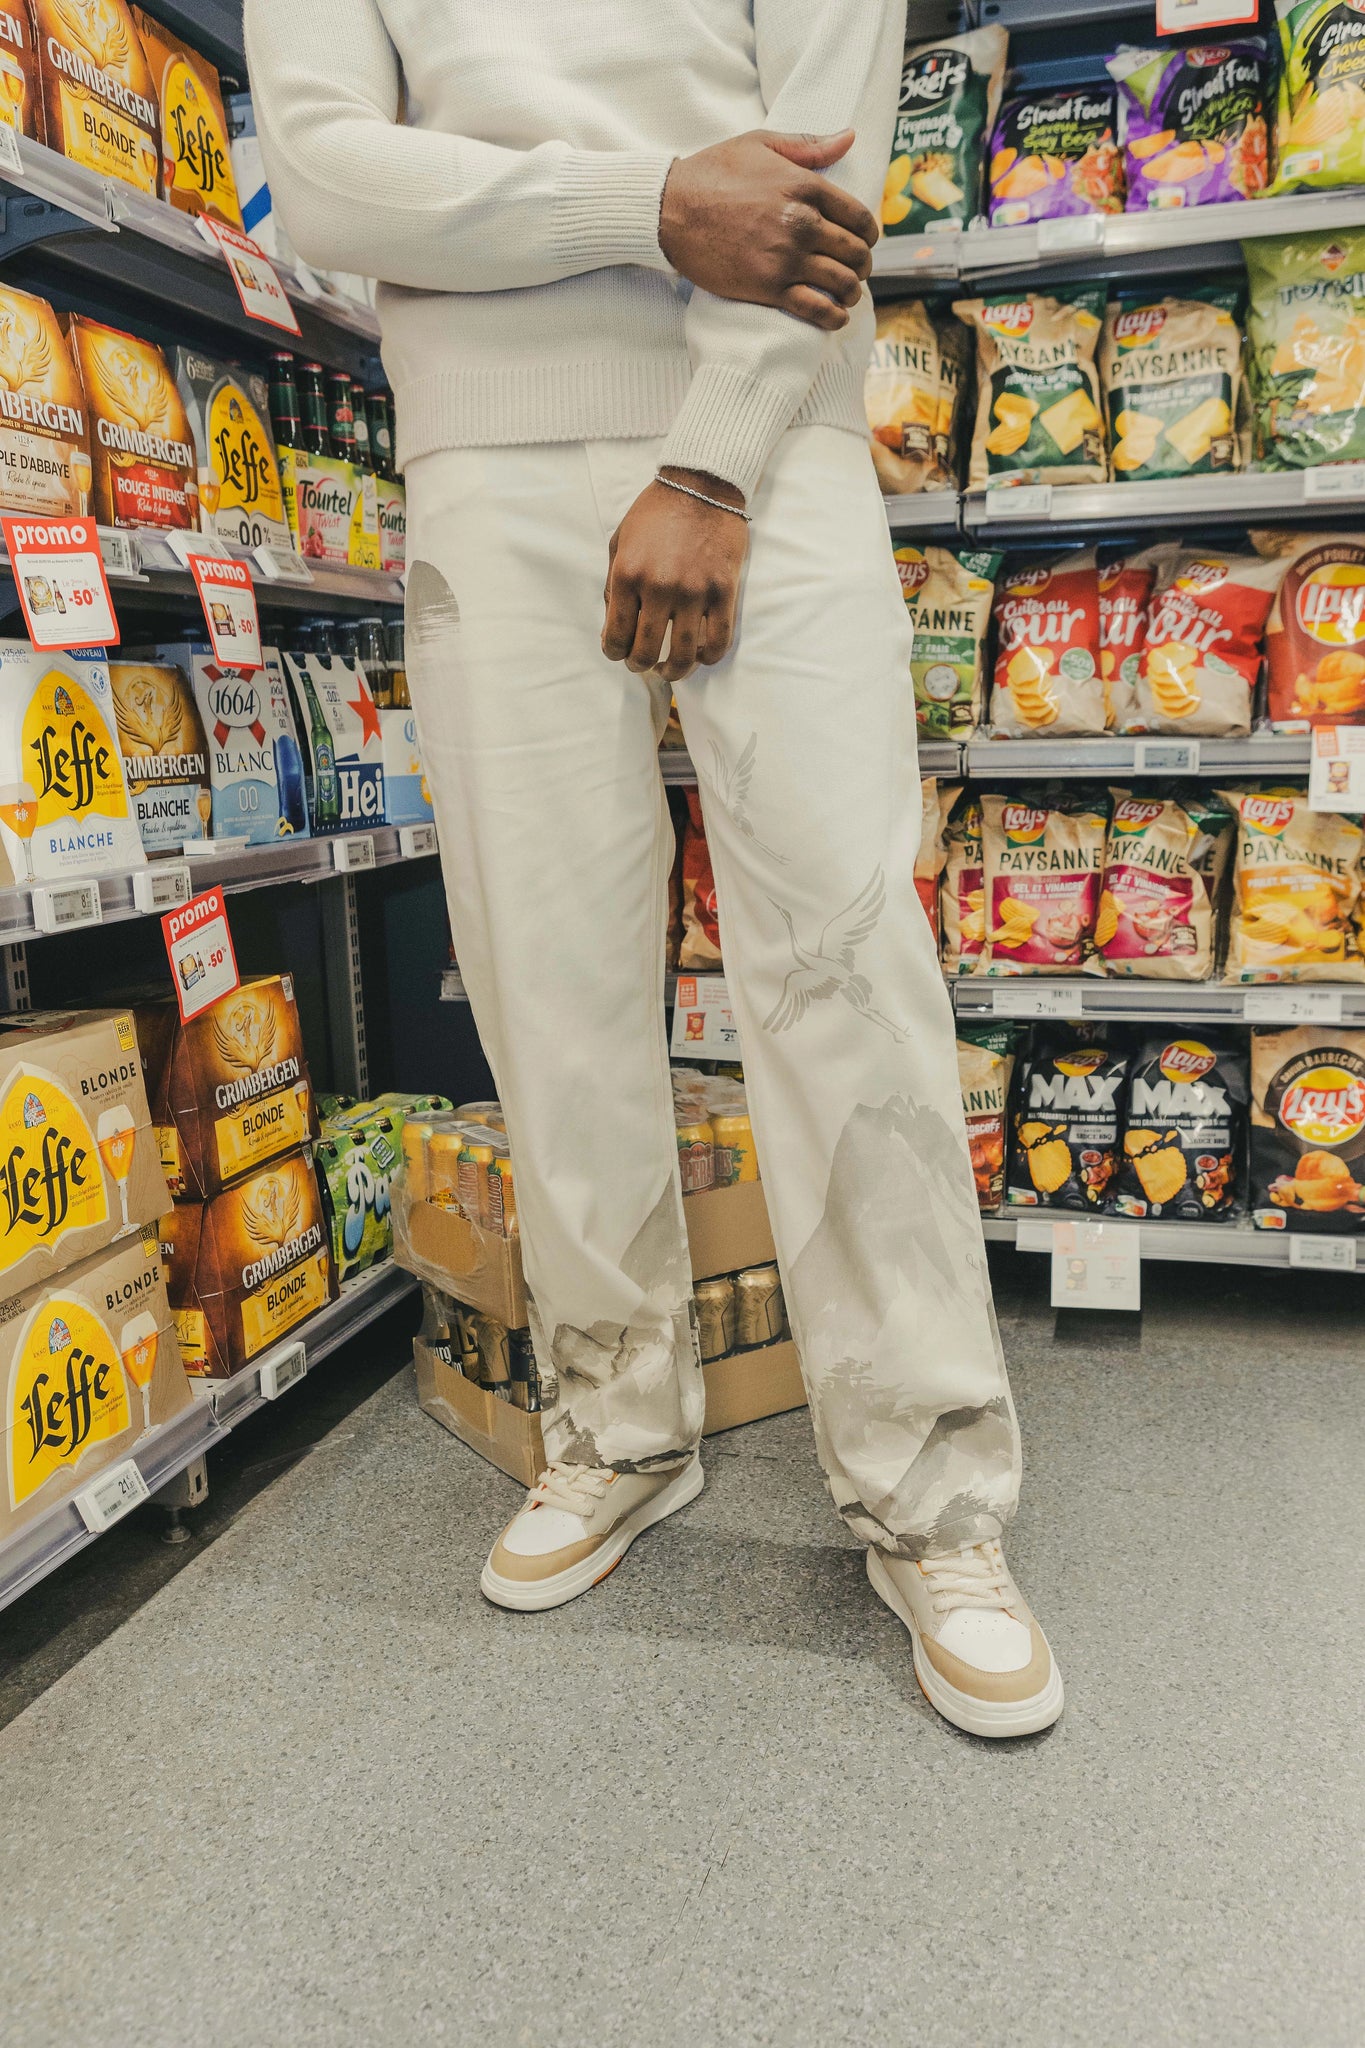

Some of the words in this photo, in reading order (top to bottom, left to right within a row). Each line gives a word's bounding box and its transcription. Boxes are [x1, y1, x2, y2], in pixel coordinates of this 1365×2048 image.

[47, 36, 157, 129] GRIMBERGEN
[1017, 98, 1072, 130] Street
[1073, 96, 1112, 120] Food
[83, 111, 137, 159] BLONDE
[171, 104, 226, 192] Leffe
[1112, 348, 1228, 378] PAYSANNE
[97, 418, 193, 468] GRIMBERGEN
[20, 455, 70, 479] D'ABBAYE
[215, 427, 270, 503] Leffe
[117, 477, 151, 499] ROUGE
[151, 484, 186, 506] INTENSE
[300, 479, 352, 516] Tourtel
[217, 527, 238, 540] BLONDE
[315, 513, 341, 528] Twist
[12, 525, 87, 552] promo
[196, 559, 246, 582] promo
[1004, 598, 1045, 620] Cuites
[71, 648, 102, 658] NOUVEAU
[215, 683, 256, 716] 1664
[30, 721, 112, 811] Leffe
[216, 750, 273, 775] BLANC
[137, 799, 191, 820] BLANCHE
[338, 768, 385, 819] Hei
[50, 832, 114, 854] BLANCHE
[1000, 848, 1102, 872] PAYSANNE
[169, 895, 218, 942] promo
[117, 1024, 130, 1035] BEER
[81, 1062, 137, 1096] BLONDE
[1305, 1052, 1364, 1072] BARBECUE
[215, 1057, 300, 1109] GRIMBERGEN
[1029, 1073, 1123, 1112] MAX
[1132, 1078, 1232, 1116] MAX
[243, 1103, 285, 1136] BLONDE
[0, 1127, 87, 1237] Leffe
[242, 1223, 322, 1289] GRIMBERGEN
[106, 1266, 160, 1310] BLONDE
[267, 1272, 307, 1311] BLONDE
[20, 1348, 111, 1464] Leffe
